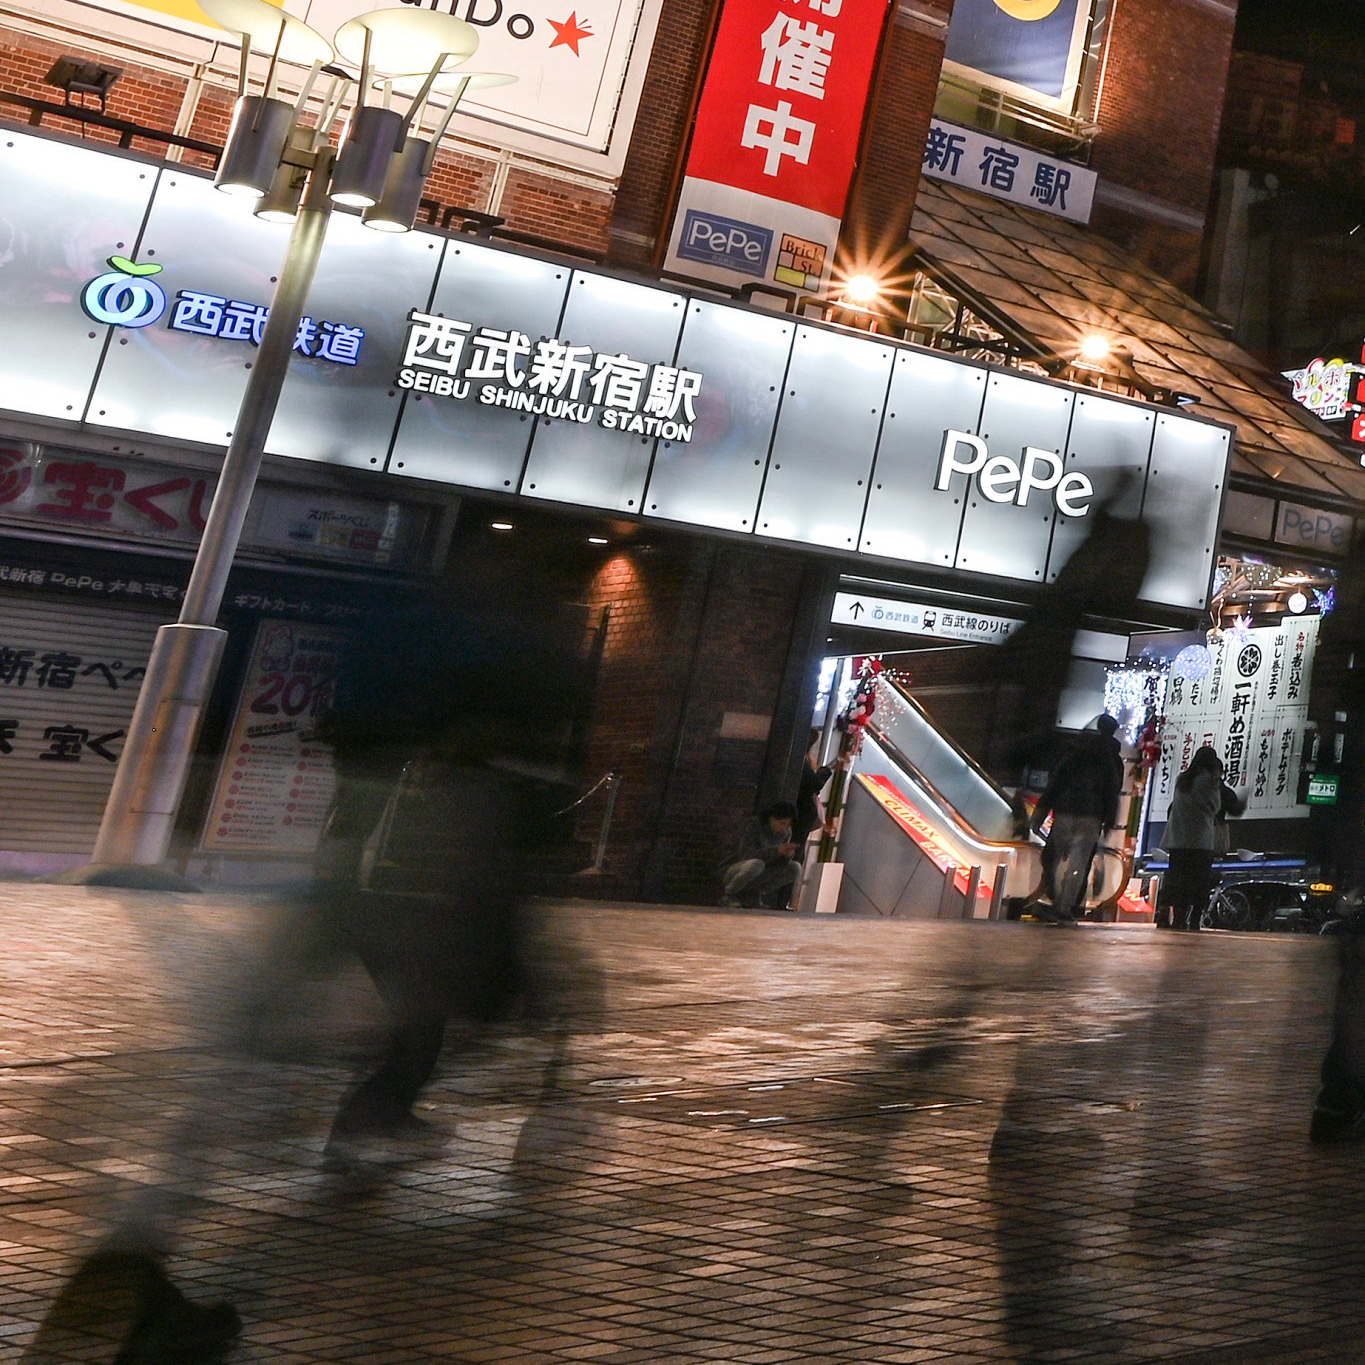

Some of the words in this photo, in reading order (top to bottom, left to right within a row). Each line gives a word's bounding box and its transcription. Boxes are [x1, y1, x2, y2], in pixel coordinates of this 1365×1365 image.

[923, 125, 1072, 212] 新宿駅
[689, 220, 762, 262] PePe
[786, 239, 822, 262] Brick
[800, 259, 816, 275] St.
[402, 312, 703, 423] 西武新宿駅
[397, 368, 471, 402] SEIBU
[479, 384, 594, 425] SHINJUKU
[601, 408, 693, 442] STATION
[934, 429, 1095, 518] PePe
[1282, 507, 1344, 548] PePe
[941, 611, 1012, 636] 西武線のりば
[1223, 681, 1252, 789] 一軒め酒場
[884, 798, 940, 839] CLIMAX
